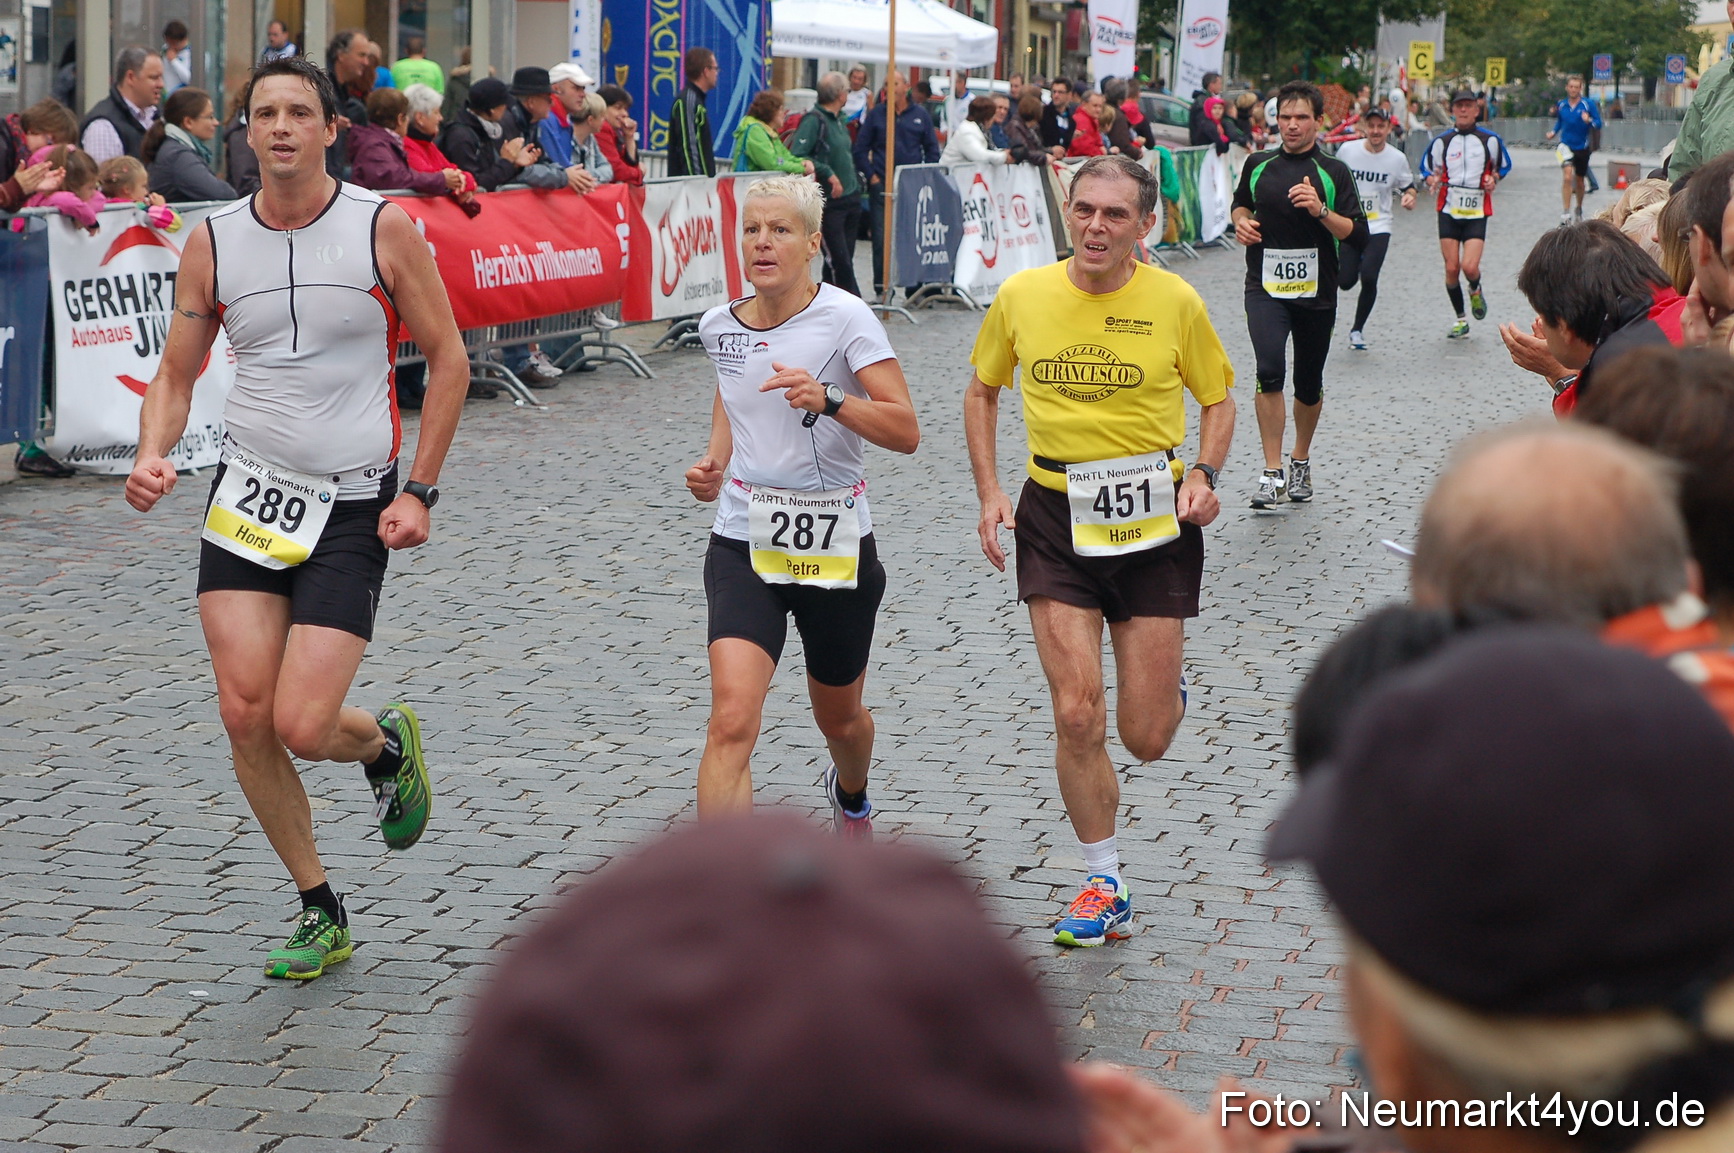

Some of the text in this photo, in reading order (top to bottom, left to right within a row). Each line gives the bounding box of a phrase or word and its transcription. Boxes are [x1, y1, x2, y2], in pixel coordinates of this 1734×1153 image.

[1415, 52, 1427, 70] C
[1490, 67, 1500, 79] D
[1459, 196, 1478, 208] 106
[471, 241, 603, 289] Herzlich willkommen
[1274, 262, 1308, 280] 468
[1276, 284, 1305, 292] Andreas
[72, 325, 133, 348] Autohaus
[1058, 346, 1117, 365] PIZZERIA
[1044, 363, 1129, 384] FRANCESCO
[234, 453, 316, 497] PARTL Neumarkt
[1069, 464, 1153, 483] PARTL Neumarkt
[236, 477, 307, 534] 289
[752, 493, 841, 508] PARTL Neumarkt
[1093, 478, 1151, 519] 451
[235, 524, 273, 551] Horst
[771, 511, 839, 550] 287
[1109, 527, 1142, 542] Hans
[786, 558, 820, 576] Petra
